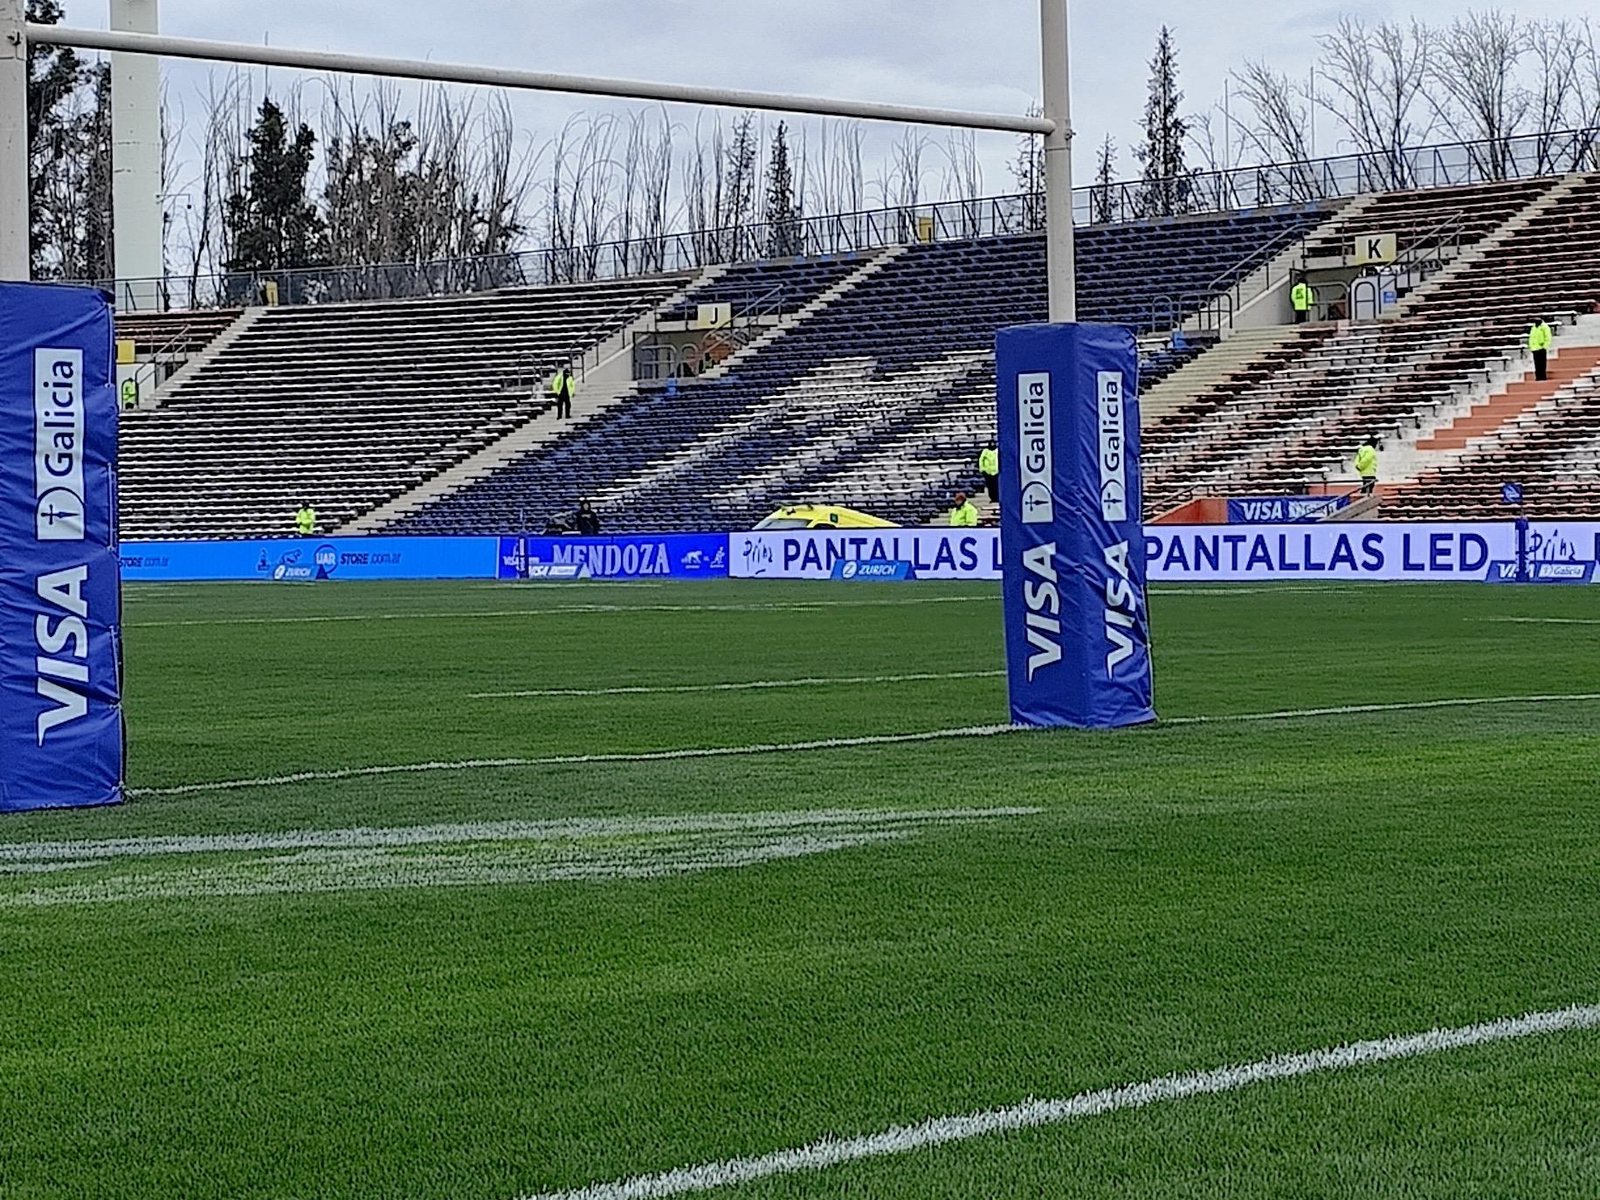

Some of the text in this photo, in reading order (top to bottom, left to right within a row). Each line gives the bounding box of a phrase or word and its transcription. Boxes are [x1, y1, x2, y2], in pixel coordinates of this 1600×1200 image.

[1368, 239, 1381, 258] K
[710, 308, 718, 324] J
[43, 358, 76, 478] Galicia
[1023, 381, 1046, 475] Galicia
[1101, 379, 1120, 472] Galicia
[1241, 501, 1284, 520] VISA
[340, 553, 369, 564] STORE
[552, 544, 670, 575] MENDOZA
[858, 564, 897, 576] ZURICH
[1144, 533, 1489, 572] PANTALLAS LED
[1498, 563, 1536, 578] VIA
[1022, 541, 1063, 683] VISA
[1103, 540, 1137, 681] VISA
[35, 564, 90, 748] VISA
